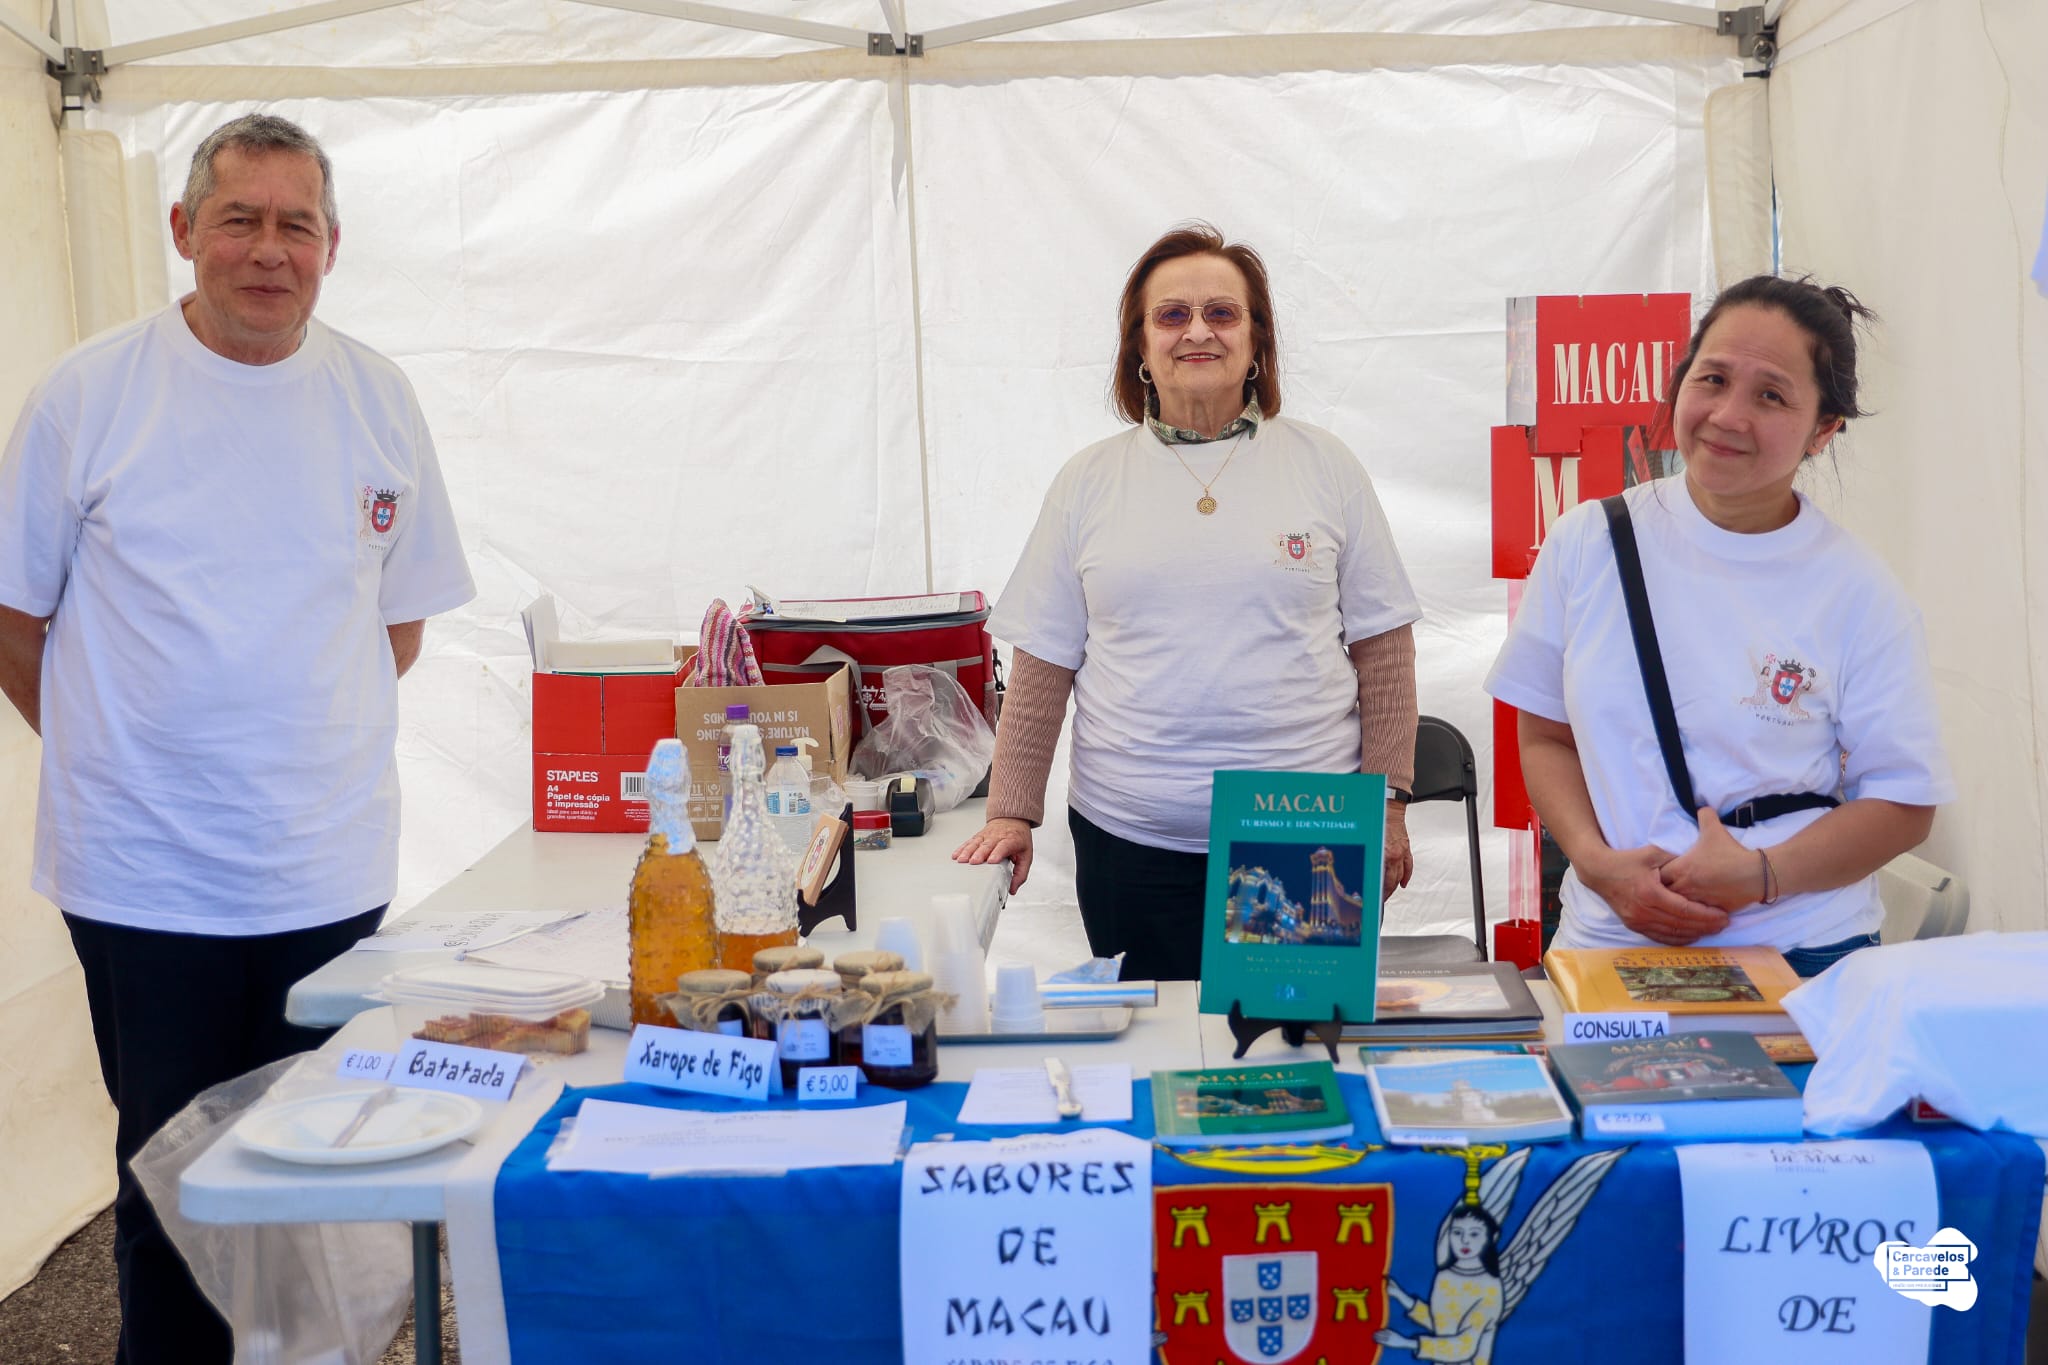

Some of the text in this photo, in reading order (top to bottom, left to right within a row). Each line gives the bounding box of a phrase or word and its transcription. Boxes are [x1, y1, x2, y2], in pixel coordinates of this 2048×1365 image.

[1552, 341, 1675, 405] MACAU
[749, 711, 772, 724] YOU
[773, 710, 785, 723] IN
[787, 710, 798, 722] IS
[546, 769, 599, 783] STAPLES
[547, 784, 559, 792] A4
[547, 792, 610, 803] Papel de cópia
[555, 800, 599, 809] impressão
[1253, 793, 1345, 813] MACAU
[1240, 819, 1357, 829] TURISMO E IDENTIDADE
[1573, 1020, 1665, 1039] CONSULTA
[408, 1050, 505, 1087] Batatada
[639, 1039, 763, 1088] Xarope de Figo
[921, 1161, 1135, 1195] SABORES
[997, 1226, 1058, 1266] DE
[1719, 1212, 1916, 1264] LIVROS
[945, 1296, 1111, 1336] MACAU
[1778, 1294, 1857, 1334] DE
